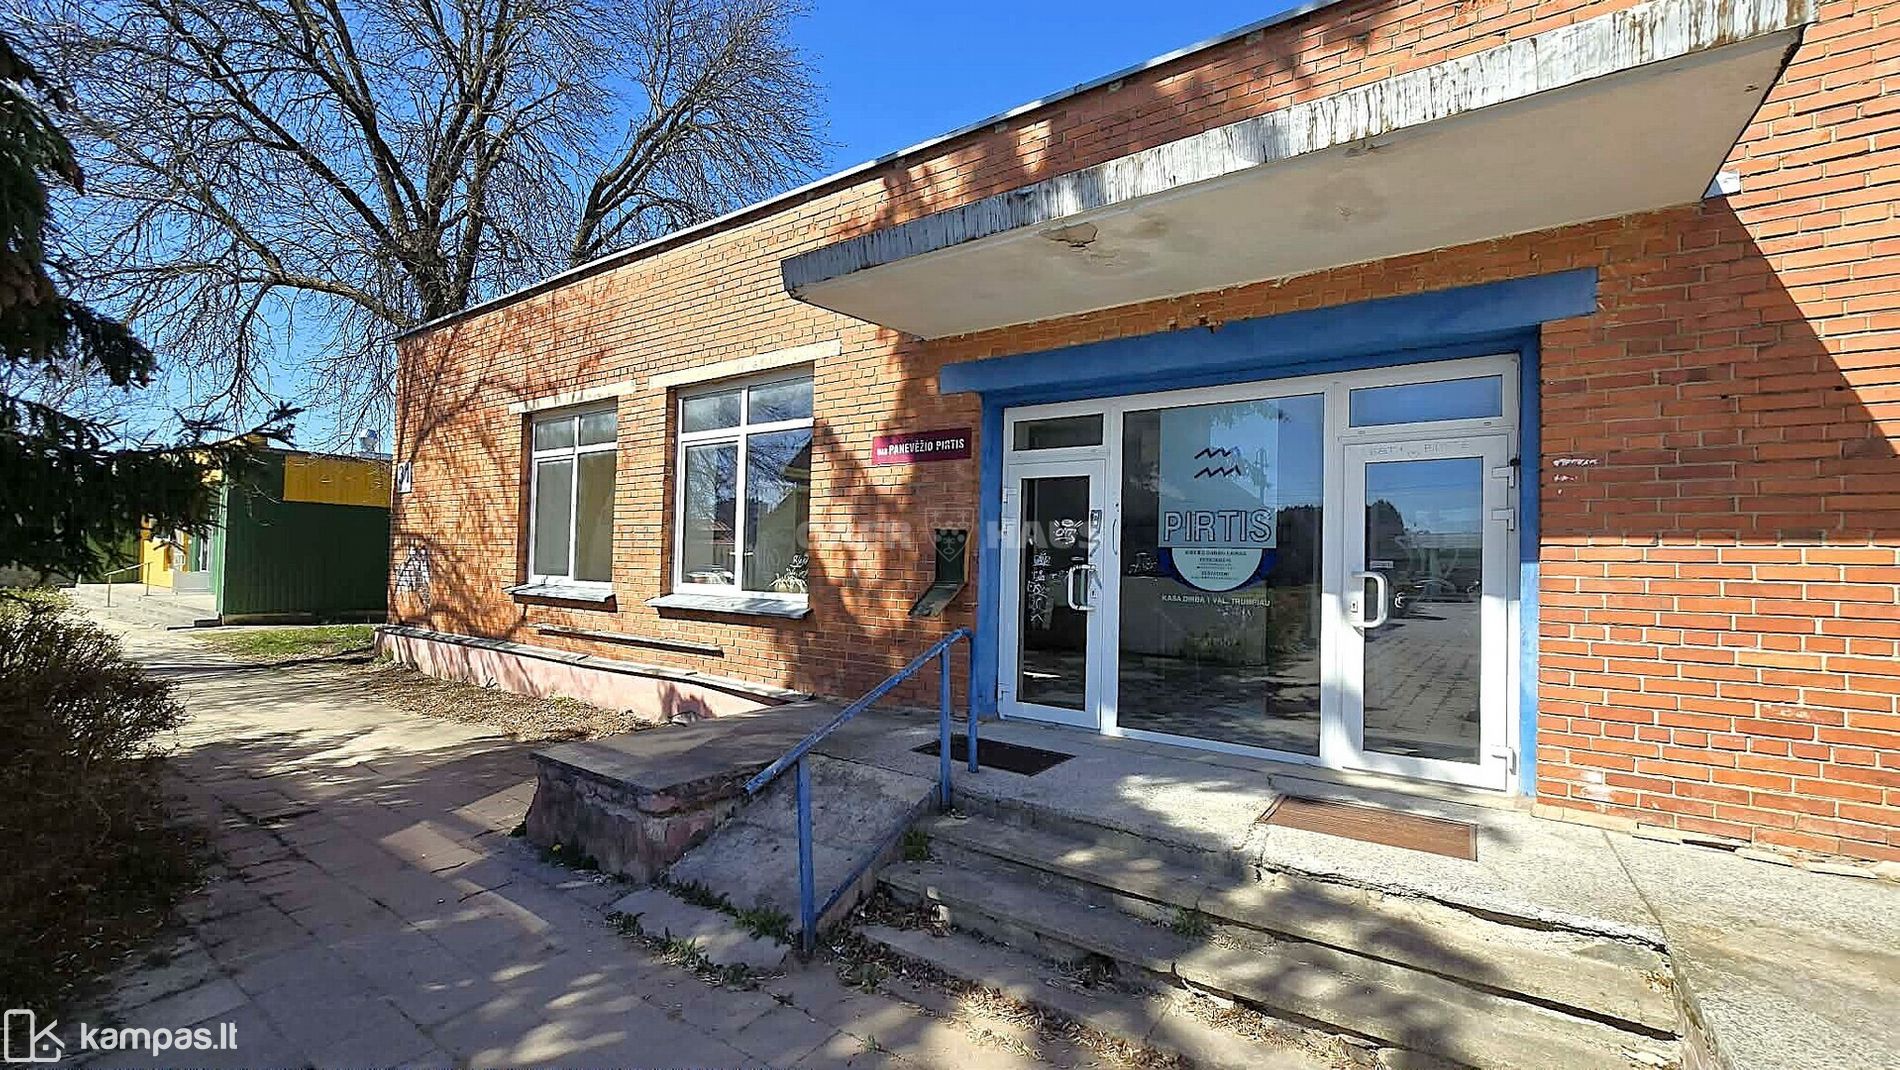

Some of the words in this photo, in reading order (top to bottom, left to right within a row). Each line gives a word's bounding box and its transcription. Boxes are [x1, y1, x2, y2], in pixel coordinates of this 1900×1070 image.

[888, 440, 934, 456] PANEVĖŽIO
[936, 438, 965, 451] PIRTIS
[1162, 508, 1273, 543] PIRTIS
[1161, 594, 1182, 603] KASA
